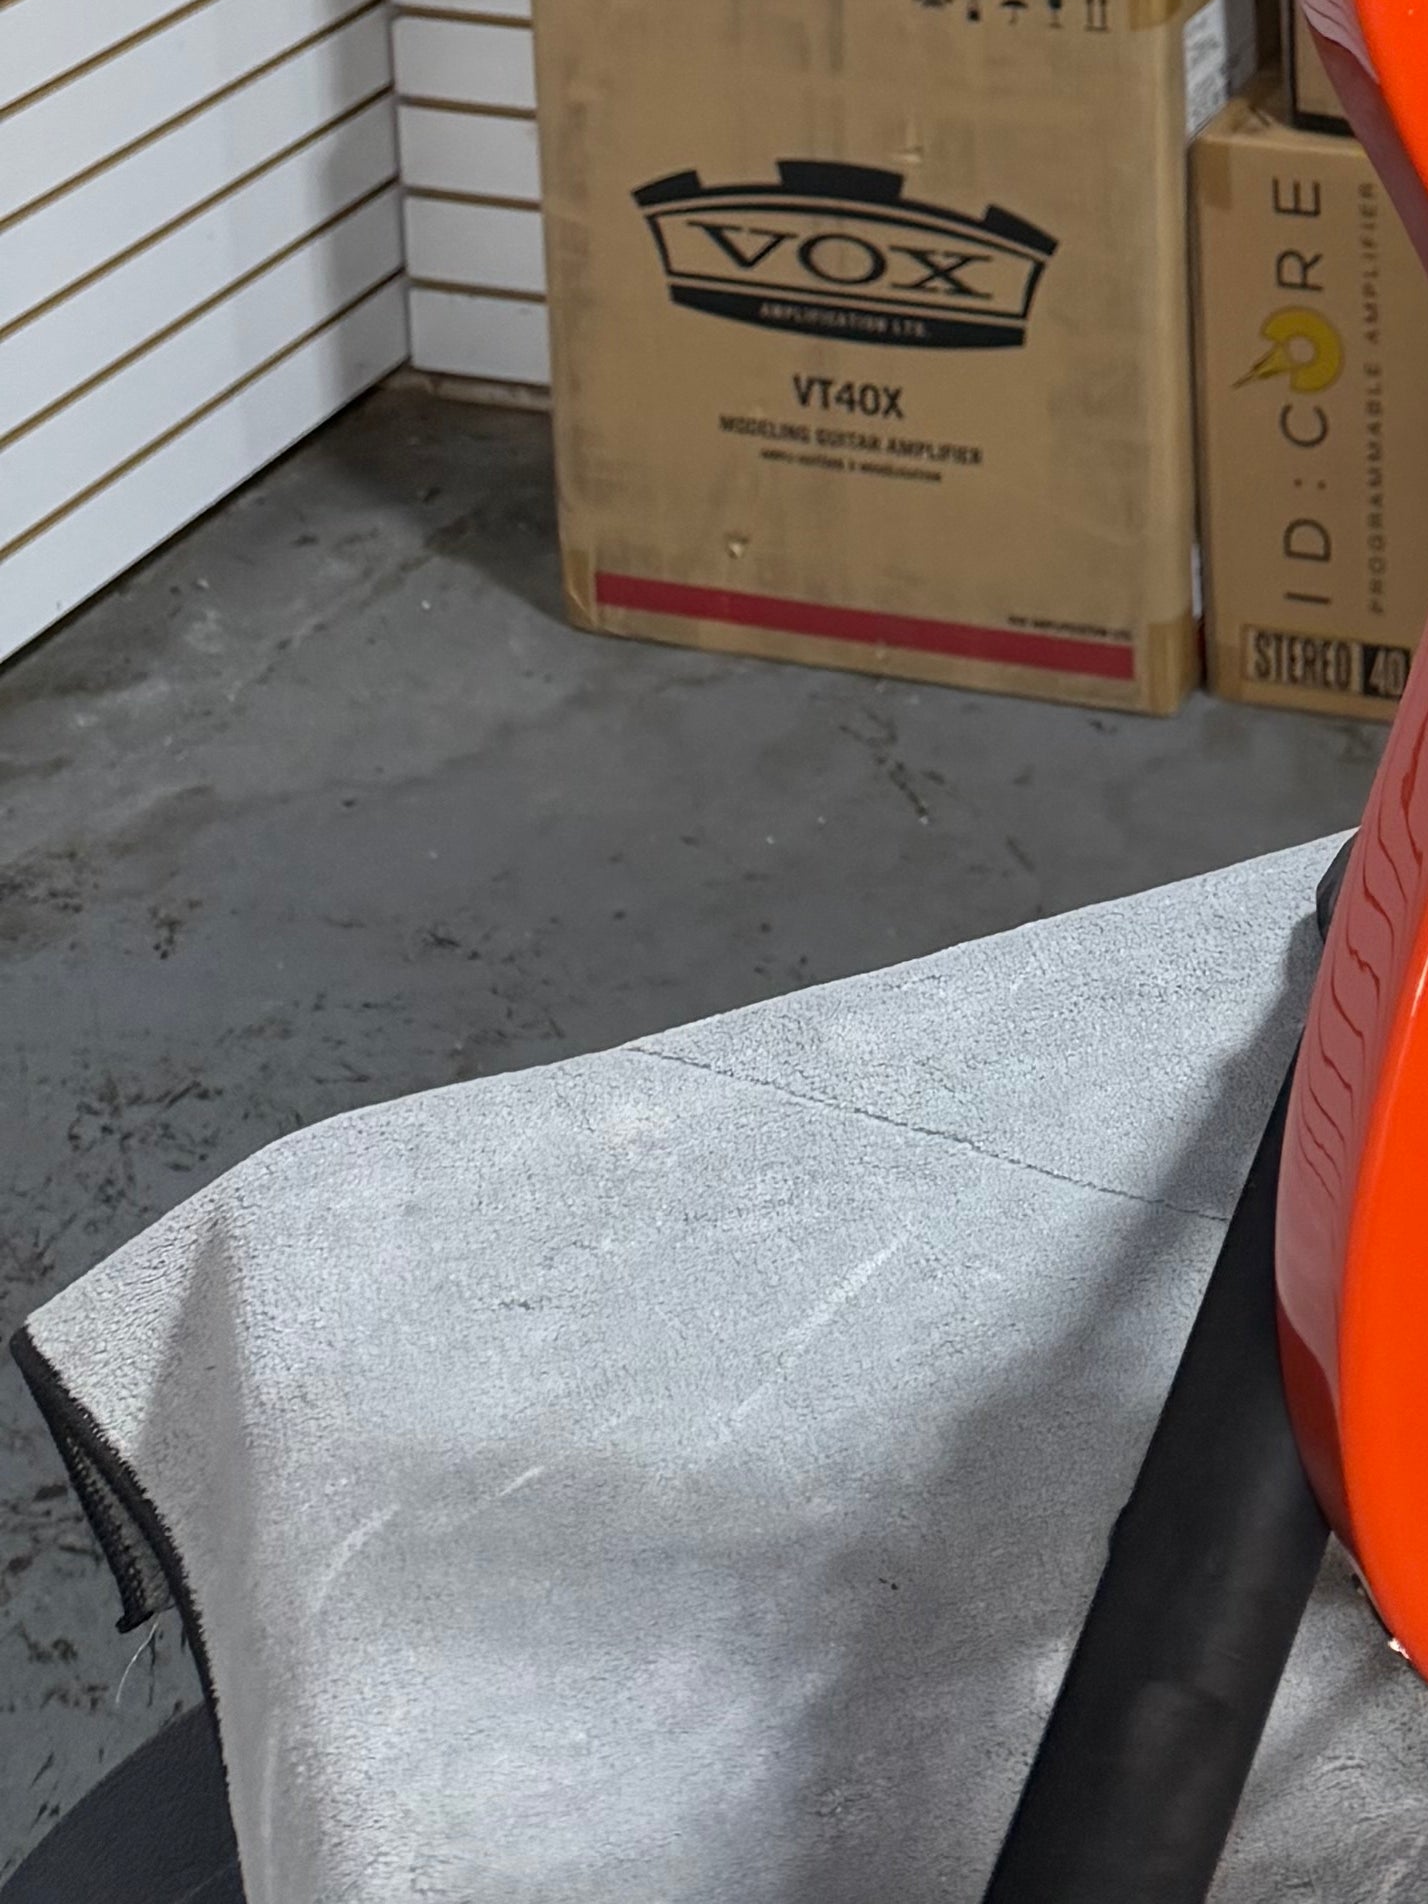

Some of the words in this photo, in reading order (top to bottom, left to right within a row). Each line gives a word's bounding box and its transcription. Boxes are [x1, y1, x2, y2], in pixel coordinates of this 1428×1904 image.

[685, 220, 994, 301] VOX
[1357, 181, 1383, 345] AMPLIFIER
[792, 373, 905, 420] VT40X
[718, 413, 811, 444] MODELING
[815, 428, 882, 453] GUITAR
[886, 438, 983, 465] AMPLIFIER
[1361, 360, 1387, 616] PROGRAMMABLE
[1253, 630, 1351, 692] STEREO
